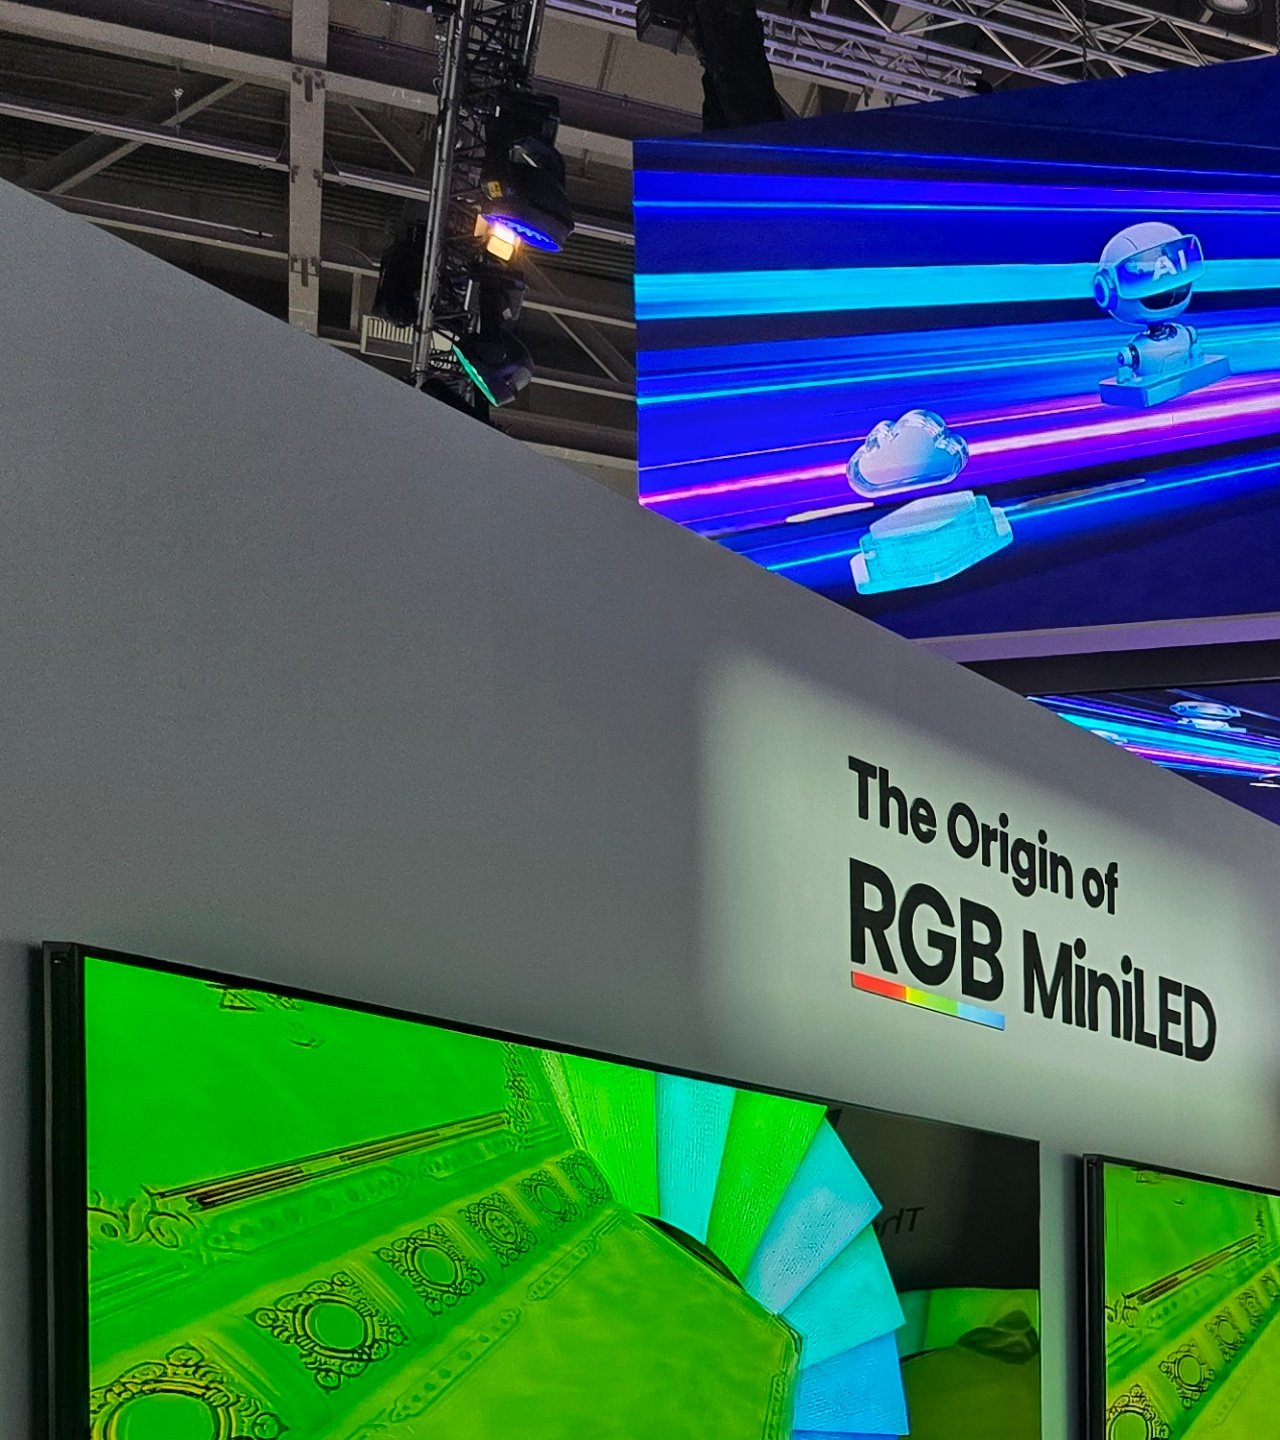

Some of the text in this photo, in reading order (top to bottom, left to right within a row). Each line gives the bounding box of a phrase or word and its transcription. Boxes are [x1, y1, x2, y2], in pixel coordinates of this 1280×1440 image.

[1152, 249, 1187, 281] AI
[847, 755, 1119, 915] The Origin of
[849, 857, 1217, 1062] RGB MiniLED
